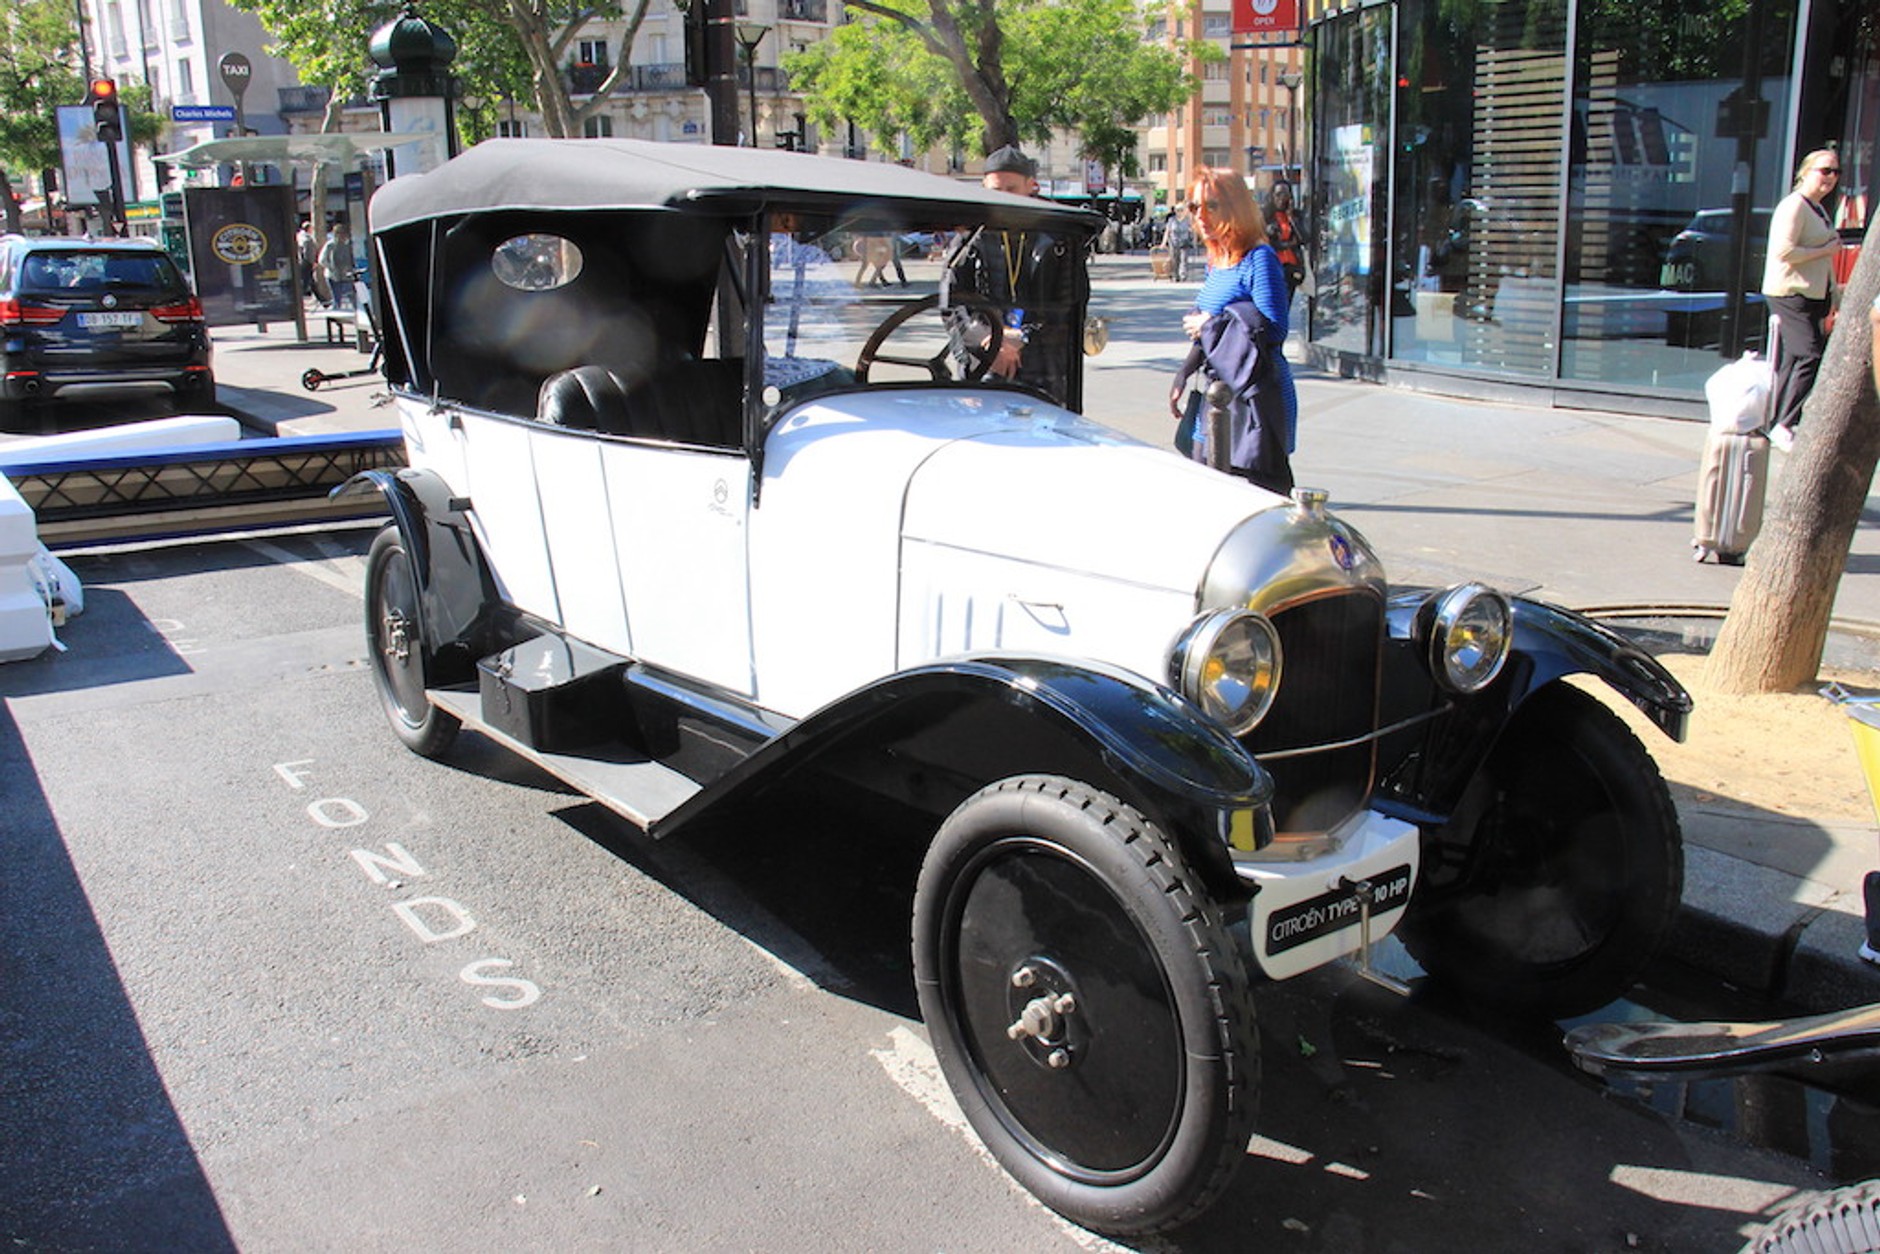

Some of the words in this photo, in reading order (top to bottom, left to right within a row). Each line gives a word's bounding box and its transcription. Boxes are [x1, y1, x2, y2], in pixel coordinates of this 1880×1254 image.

[1253, 16, 1275, 26] OPEN
[222, 64, 249, 76] TAXI
[175, 109, 203, 119] Charles
[204, 109, 233, 119] Michels
[273, 758, 541, 1009] FONDS
[1327, 897, 1359, 921] TYPE
[1374, 884, 1388, 903] 10
[1389, 877, 1408, 898] HP
